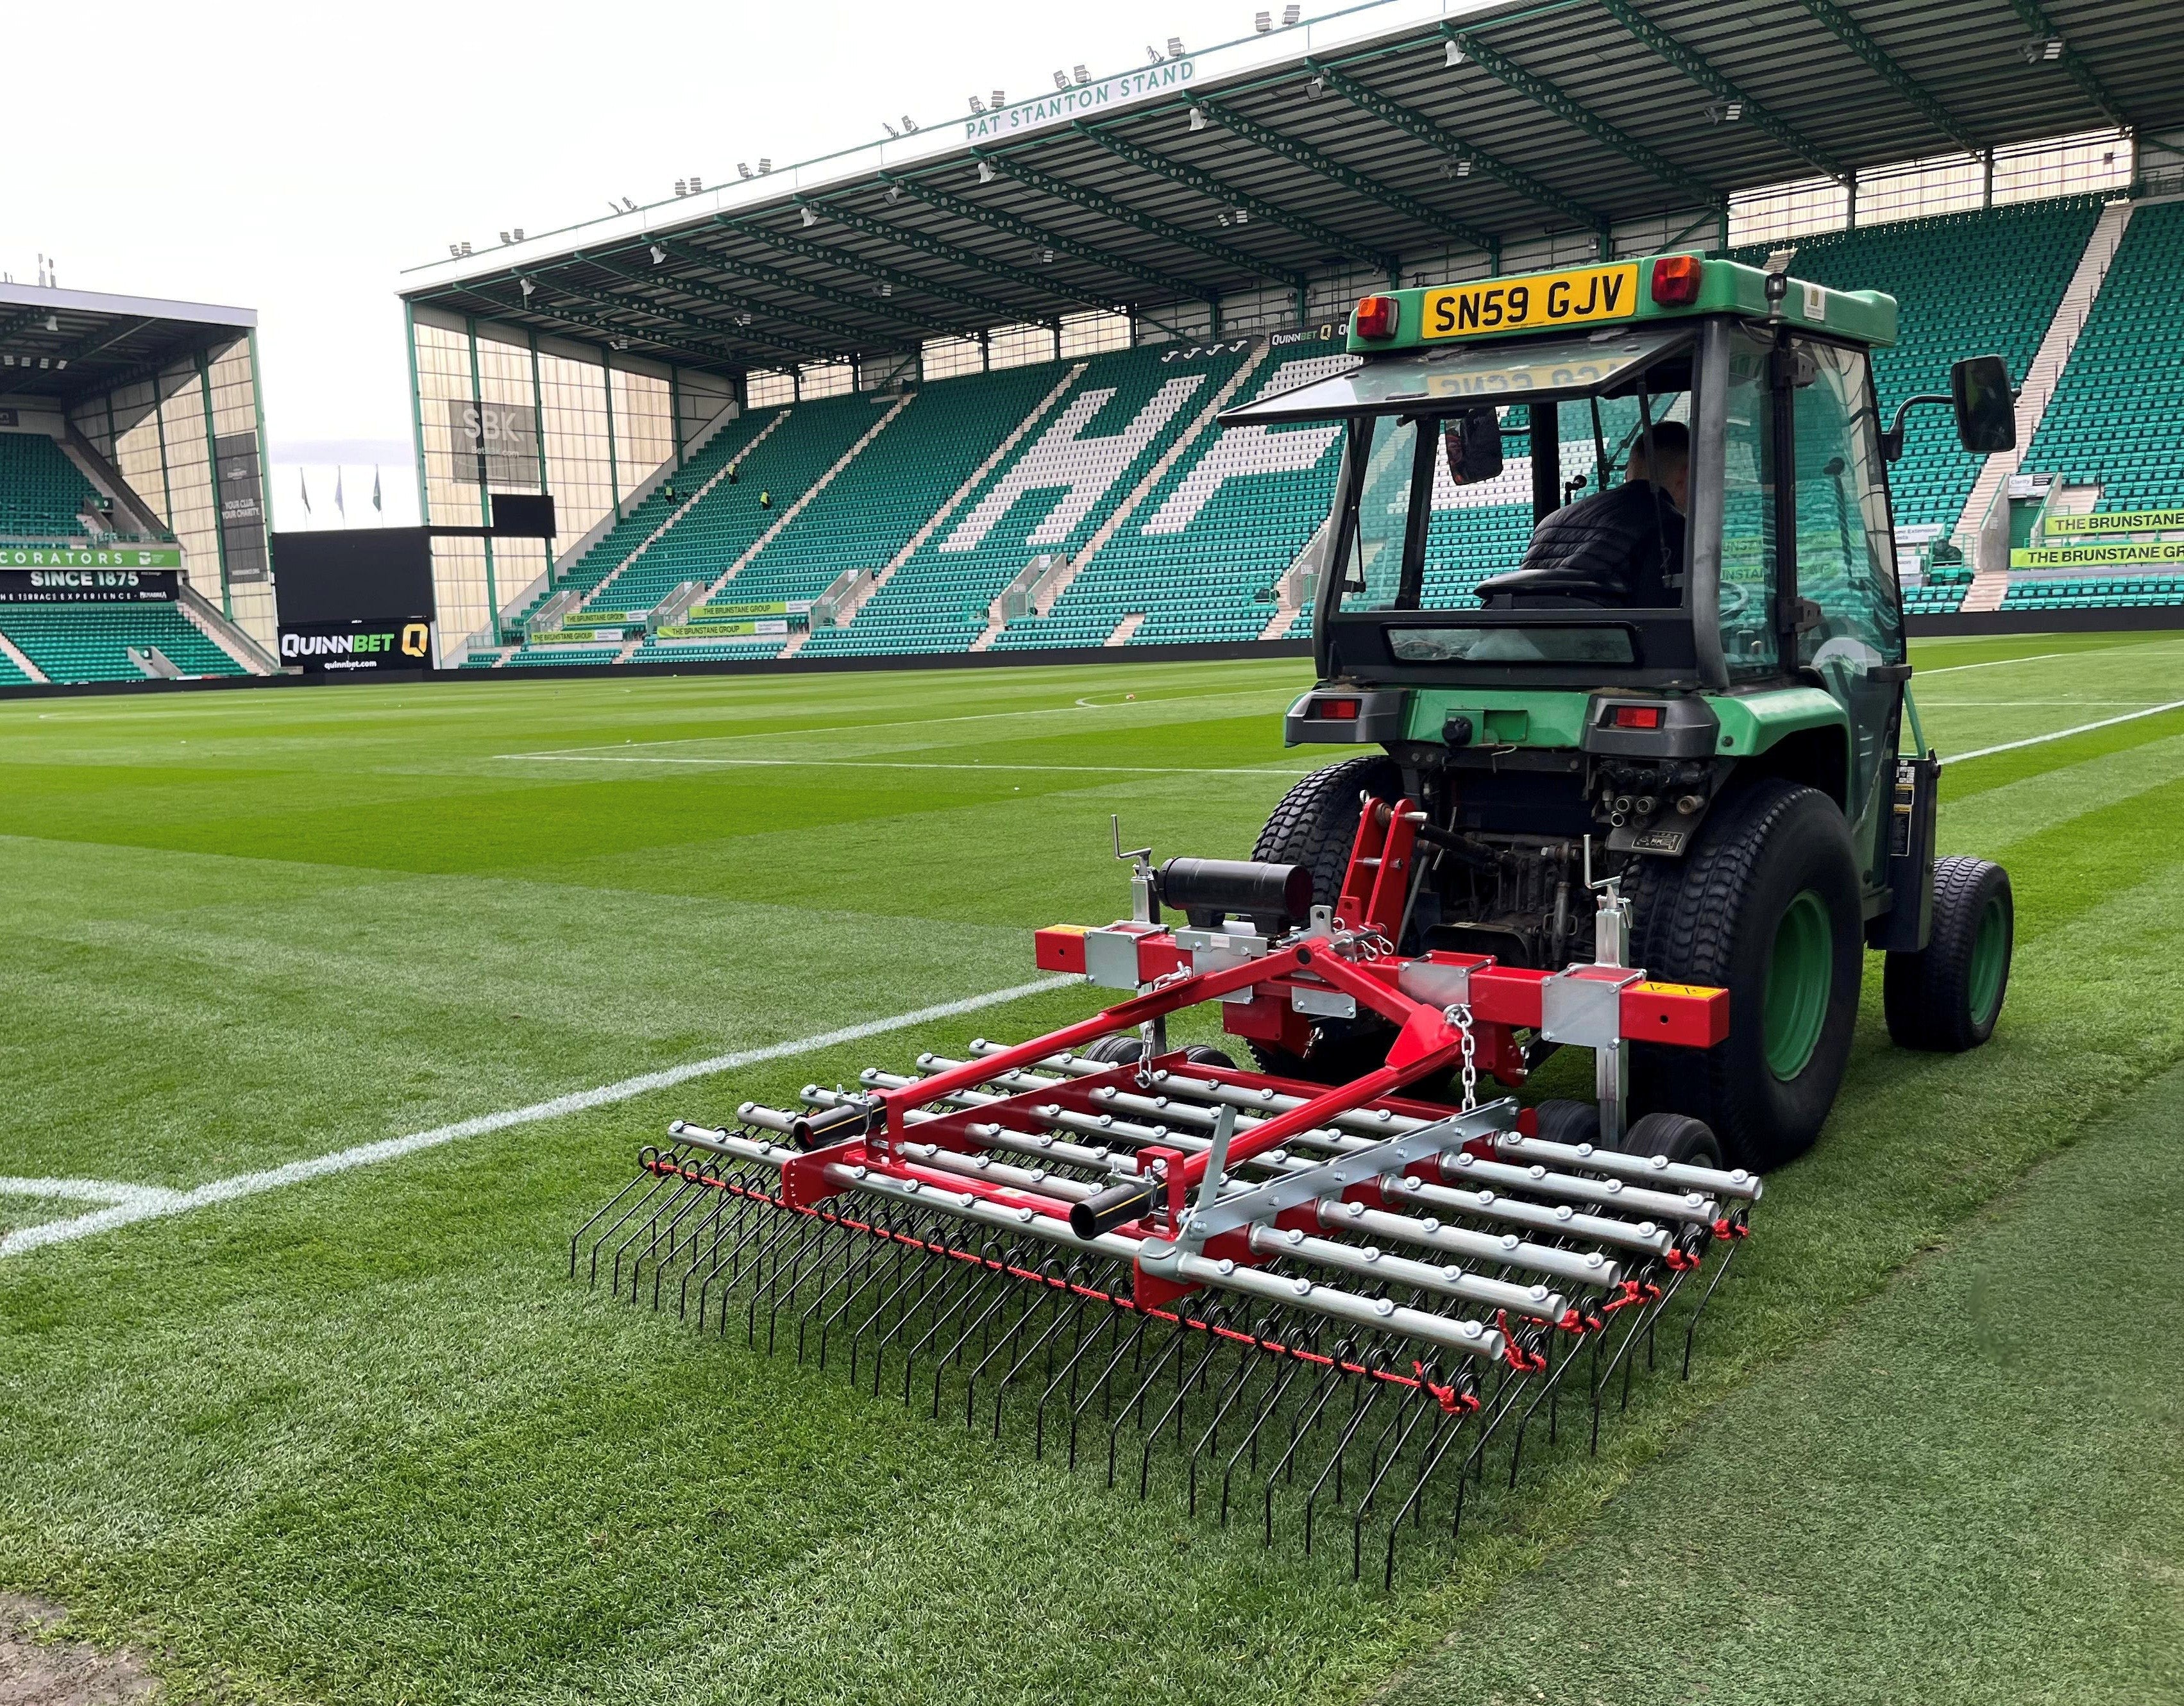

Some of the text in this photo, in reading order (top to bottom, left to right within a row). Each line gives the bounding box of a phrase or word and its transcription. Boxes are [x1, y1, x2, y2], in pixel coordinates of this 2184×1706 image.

[965, 61, 1194, 140] PAT STANTON STAND
[1435, 274, 1624, 332] SN59 GJV
[1271, 330, 1317, 345] QUINNBET
[462, 408, 520, 442] SBK
[2055, 518, 2086, 531] THE
[2027, 552, 2058, 563] THE
[2061, 546, 2160, 562] BRUNSTANE
[31, 571, 139, 587] SINCE 1875
[60, 592, 130, 601] EXPERIENCE
[715, 605, 749, 614] BRUNSTANE
[749, 604, 770, 612] GROUP
[684, 626, 718, 634] BRUNSTANE
[282, 633, 394, 657] QUINNBET
